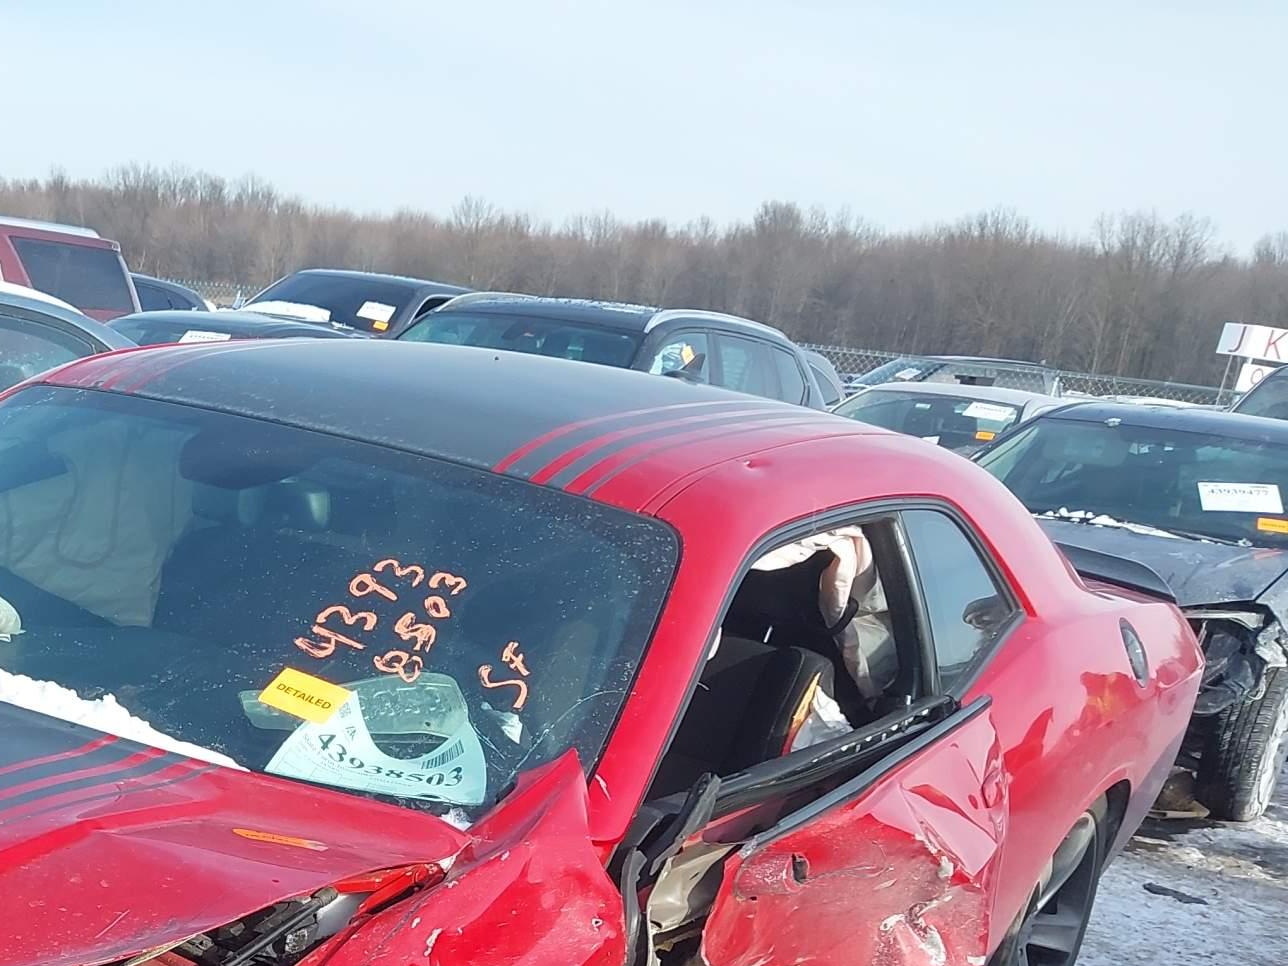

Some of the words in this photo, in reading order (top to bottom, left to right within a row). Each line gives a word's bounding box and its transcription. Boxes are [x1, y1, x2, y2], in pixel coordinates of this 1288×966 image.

[1228, 326, 1247, 352] J
[1263, 329, 1288, 360] K
[294, 558, 425, 658] 4393
[373, 572, 468, 683] 8503
[275, 682, 332, 710] DETAILED
[318, 733, 463, 787] 43938503
